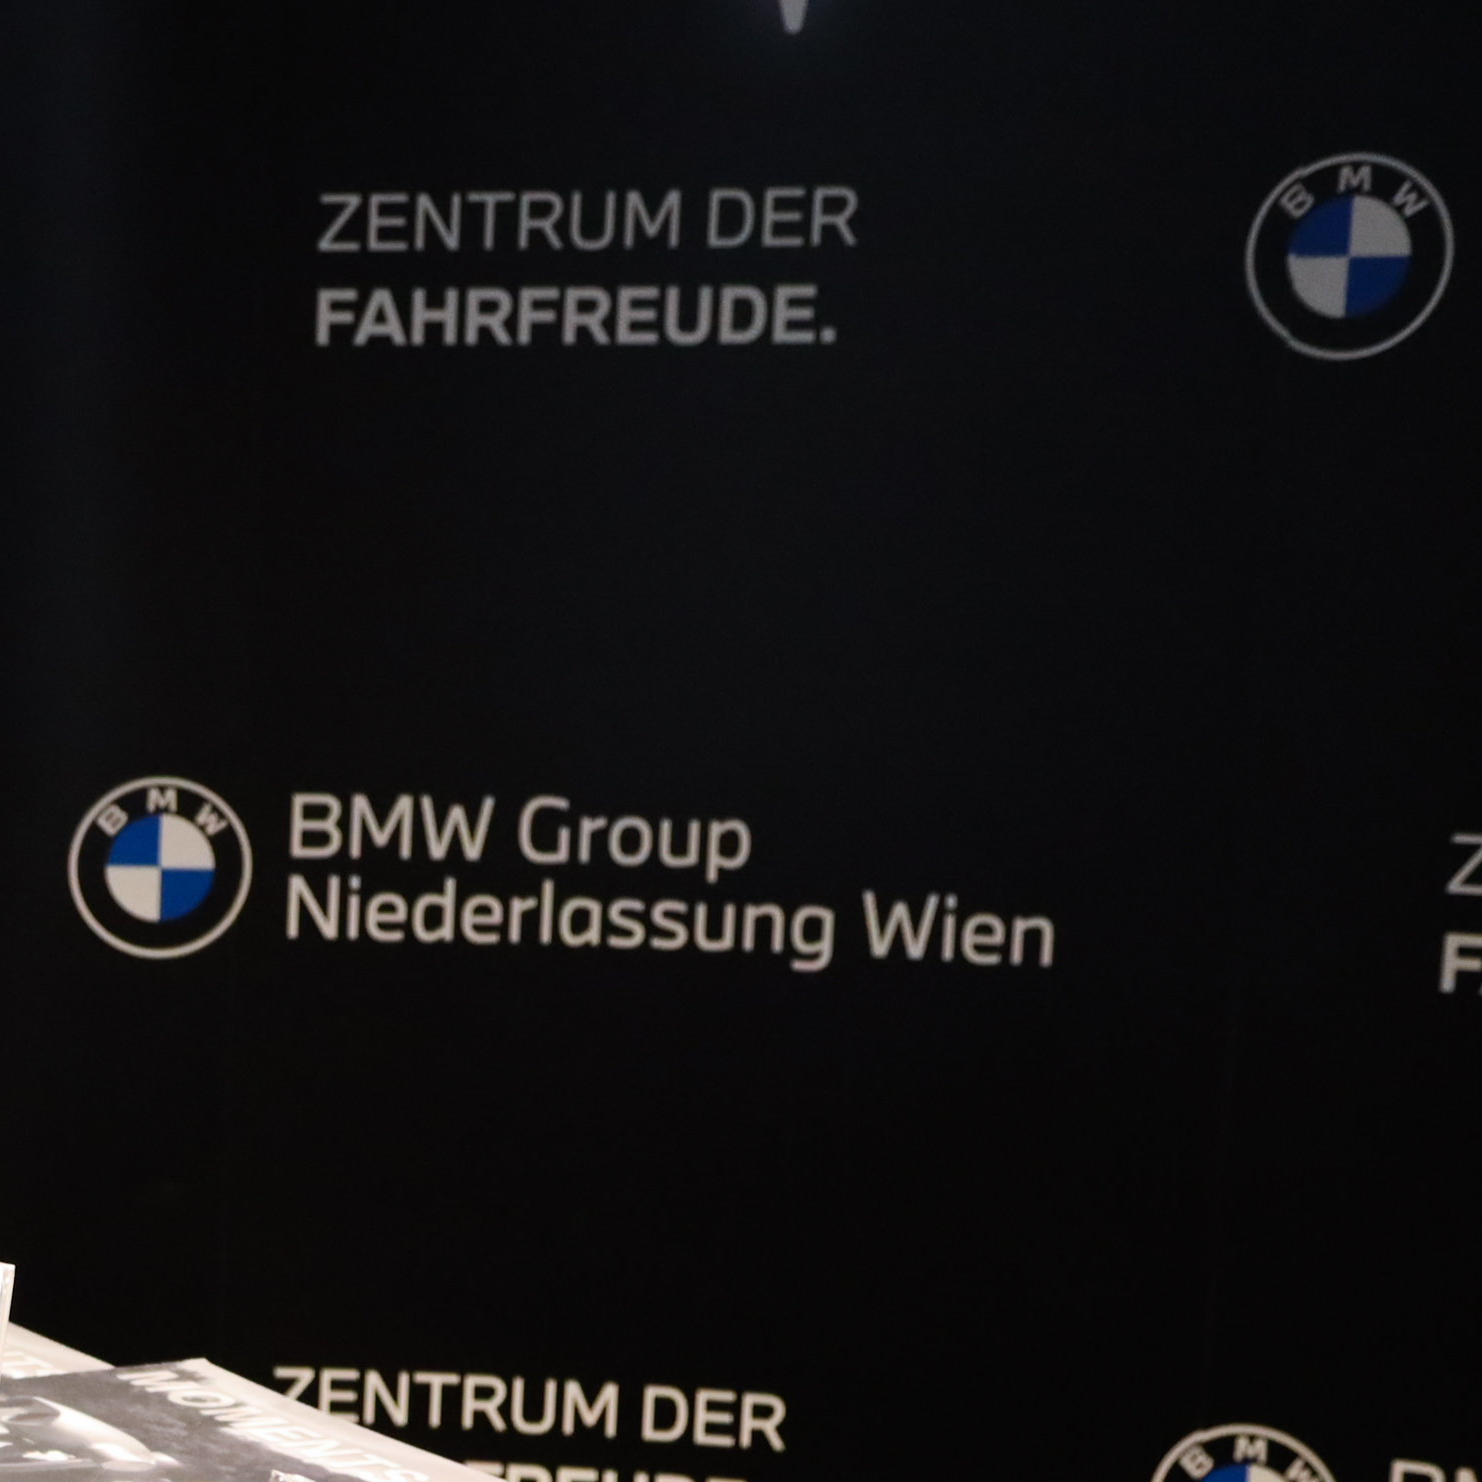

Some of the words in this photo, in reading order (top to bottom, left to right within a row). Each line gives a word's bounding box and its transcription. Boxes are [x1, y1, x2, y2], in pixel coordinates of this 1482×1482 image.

[317, 189, 683, 252] ZENTRUM
[706, 185, 860, 249] DER
[315, 284, 836, 347] FAHRFREUDE.
[289, 792, 496, 861] BMW
[518, 795, 752, 884] Group
[286, 873, 836, 972] Niederlassung
[862, 889, 1055, 967] Wien
[273, 1365, 621, 1439] ZENTRUM
[640, 1383, 788, 1452] DER
